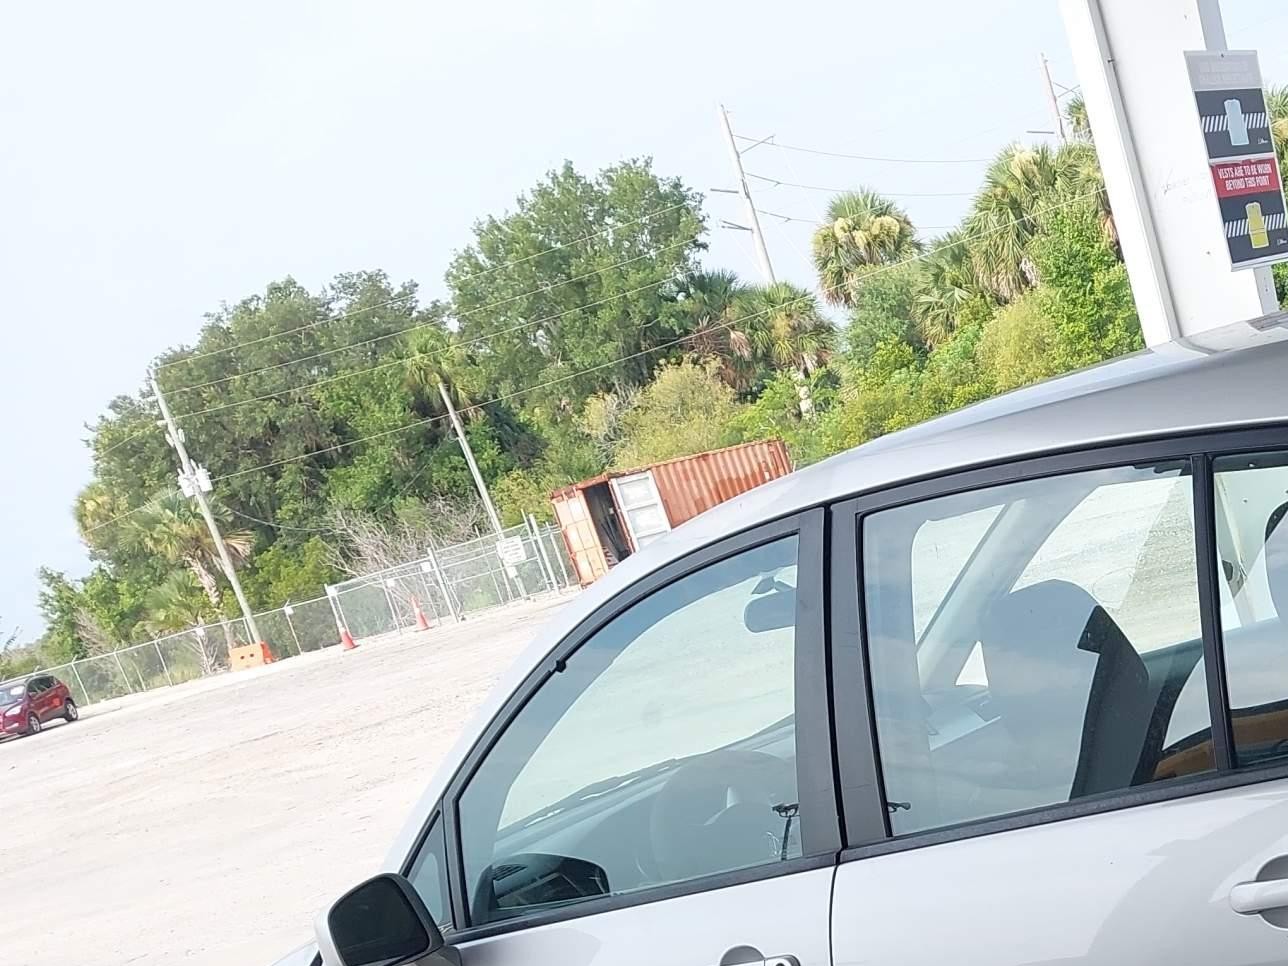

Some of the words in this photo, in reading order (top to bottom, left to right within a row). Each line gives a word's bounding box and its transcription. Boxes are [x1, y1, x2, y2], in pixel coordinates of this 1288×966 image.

[1218, 168, 1234, 179] VESTS
[1234, 166, 1244, 176] ARE
[1243, 165, 1250, 175] TO
[1251, 165, 1258, 175] BE
[1257, 163, 1272, 173] WORN
[1225, 178, 1245, 190] BEYOND
[1245, 177, 1256, 187] THIS
[1256, 176, 1269, 186] POINT
